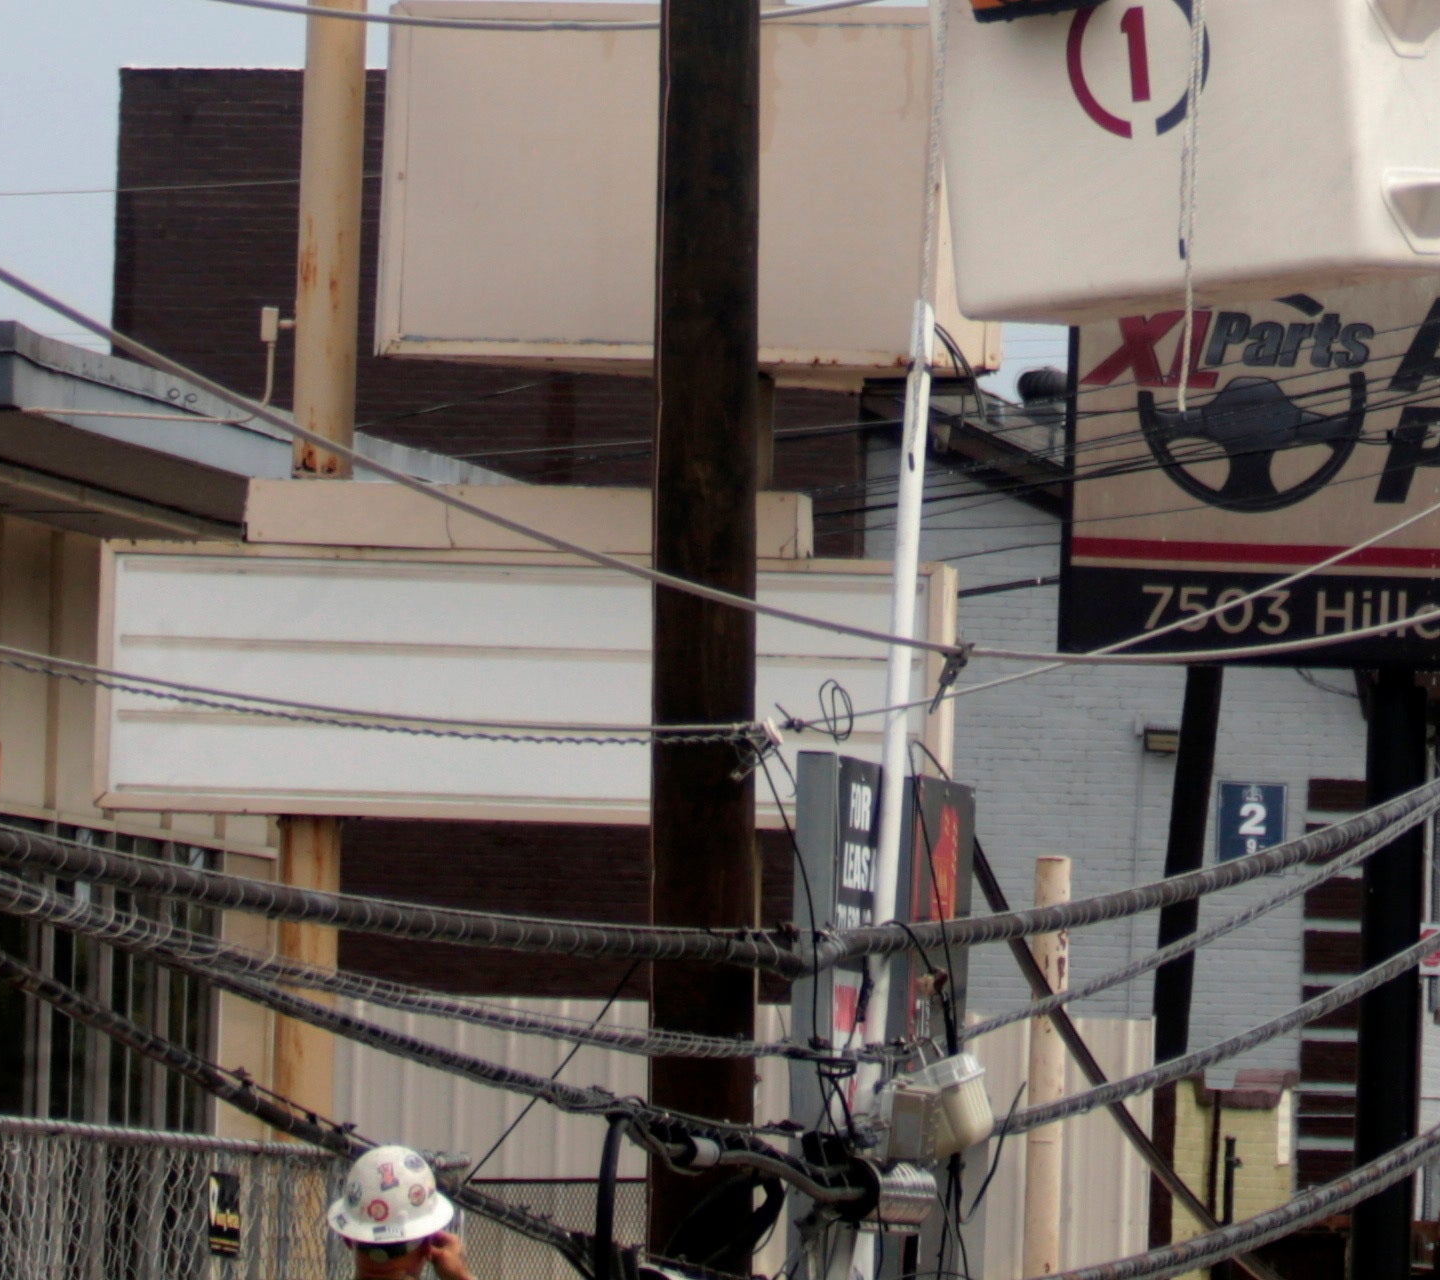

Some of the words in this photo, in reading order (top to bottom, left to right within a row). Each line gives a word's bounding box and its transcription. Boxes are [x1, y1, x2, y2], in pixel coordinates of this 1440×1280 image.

[1120, 6, 1151, 103] 1
[1204, 312, 1375, 369] Parts
[1141, 584, 1291, 636] 7503
[849, 782, 872, 832] FOR
[1238, 802, 1267, 835] 2
[842, 841, 877, 892] LEAS
